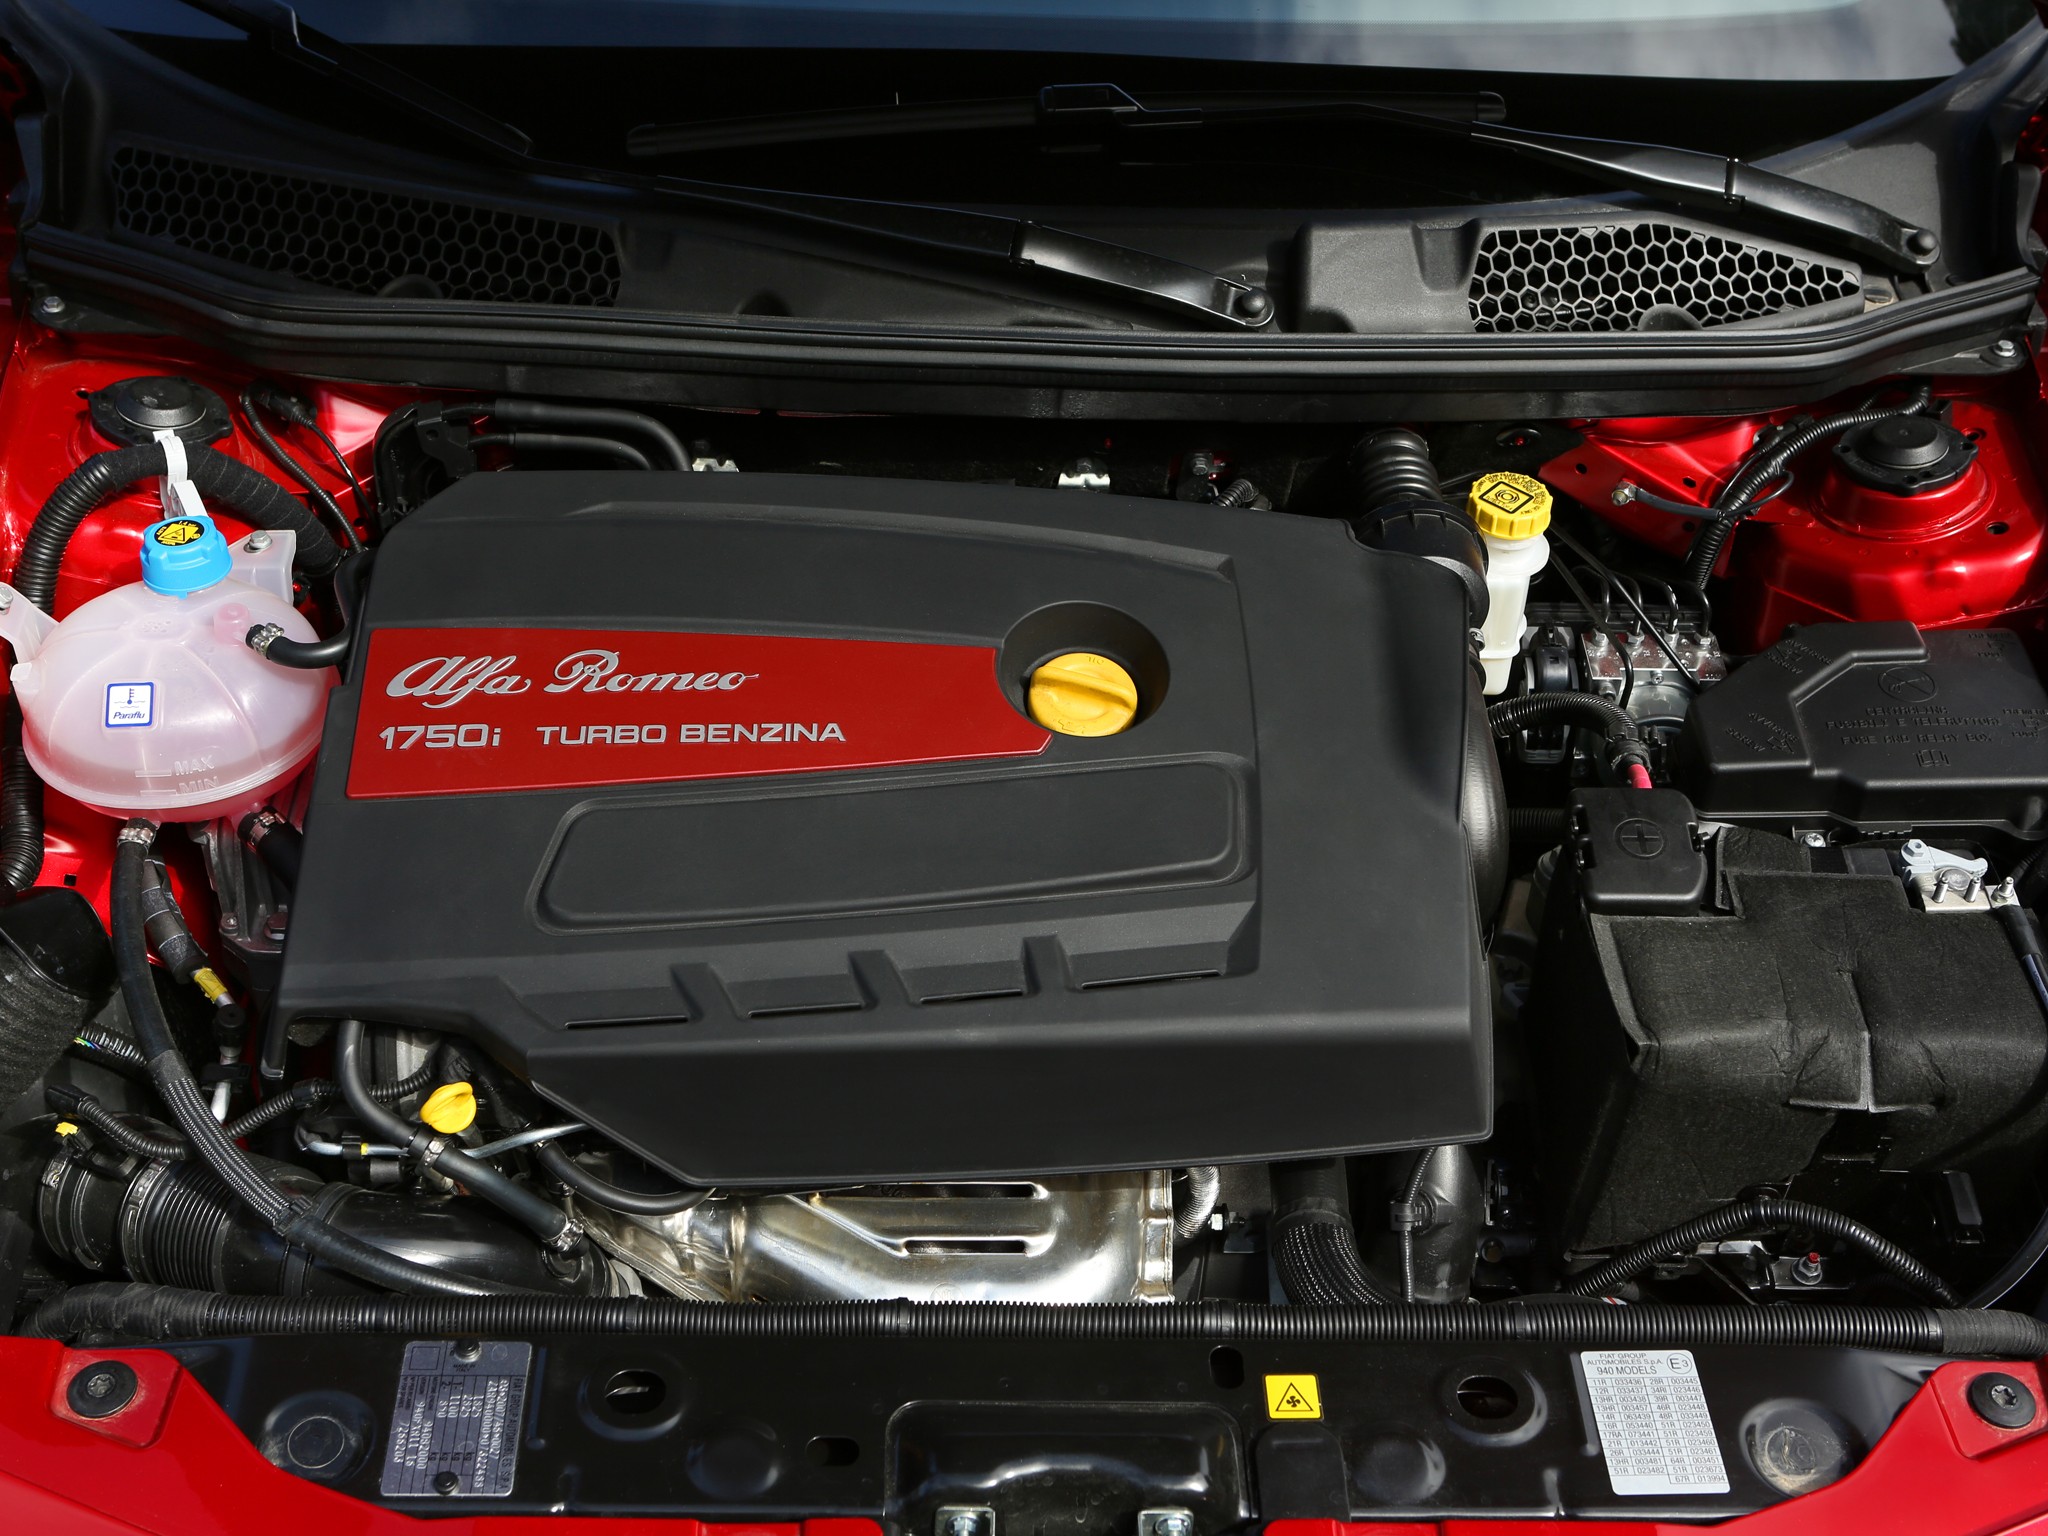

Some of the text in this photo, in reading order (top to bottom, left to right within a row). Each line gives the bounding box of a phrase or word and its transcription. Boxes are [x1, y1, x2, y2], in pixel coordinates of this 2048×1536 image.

[385, 649, 759, 709] Alfa Romeo
[113, 711, 145, 719] Paraflu
[378, 722, 846, 750] 1750i TURBO BENZINA
[1747, 712, 1800, 743] AVVITARE
[1725, 727, 1767, 753] SCREW
[1841, 732, 1993, 745] FUSE AND RELAY BOX
[174, 754, 215, 776] MAX
[179, 776, 220, 795] MIN
[1597, 1366, 1657, 1375] 940 MODELS
[512, 1378, 523, 1392] FIAT
[448, 1395, 460, 1418] 1100
[509, 1395, 521, 1416] GROUP
[502, 1420, 517, 1467] AUTOMOBILES
[428, 1452, 439, 1461] kg
[440, 1452, 451, 1461] kg
[452, 1452, 463, 1461] kg
[464, 1452, 474, 1461] kg
